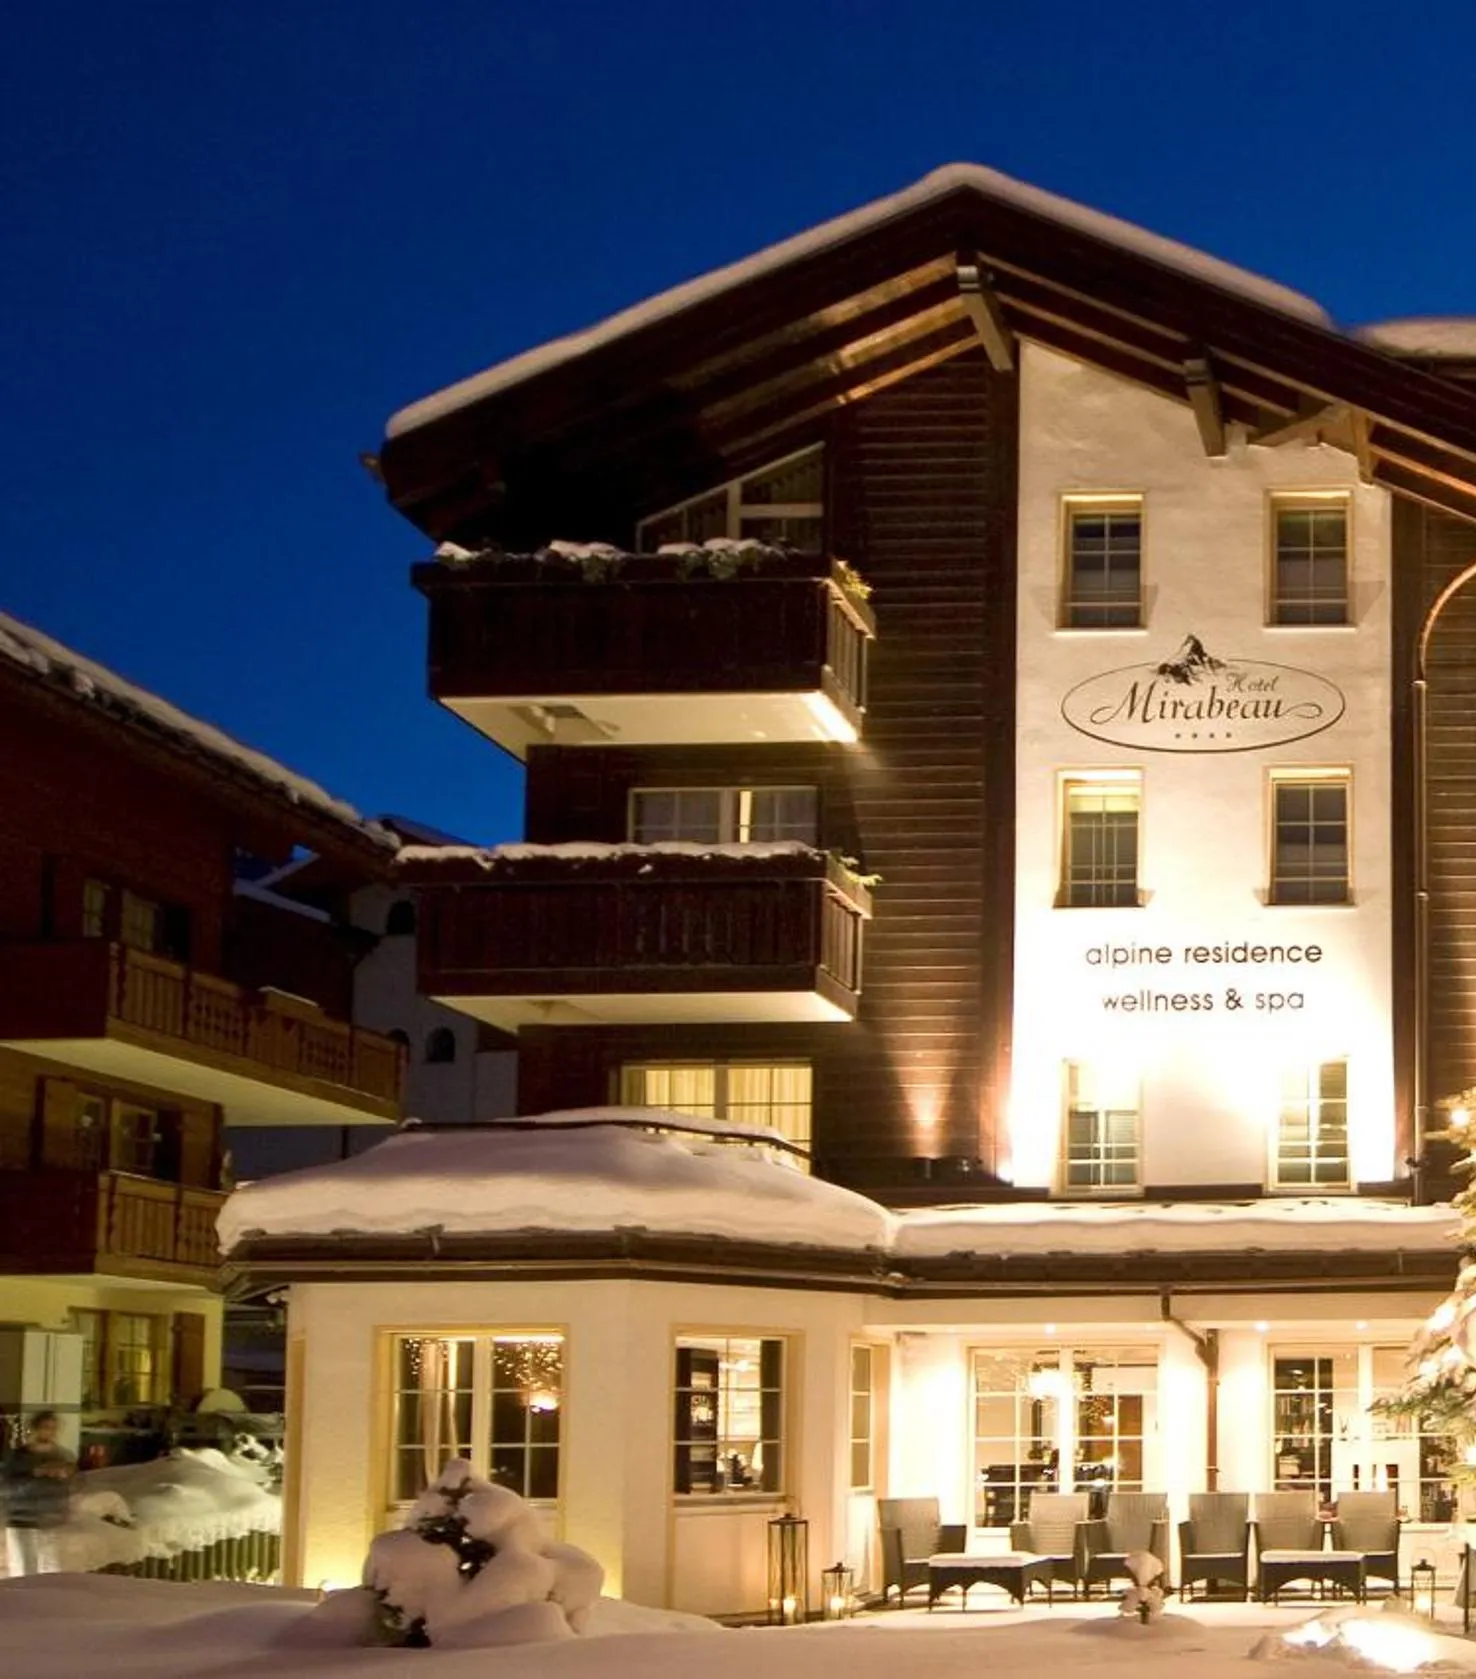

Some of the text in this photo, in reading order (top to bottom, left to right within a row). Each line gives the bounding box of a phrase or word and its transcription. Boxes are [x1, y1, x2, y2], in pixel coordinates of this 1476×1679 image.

[1225, 672, 1281, 694] Hotel
[1089, 680, 1323, 725] Mirabeau
[1085, 941, 1323, 969] alpine residence
[1101, 988, 1305, 1015] wellness & spa
